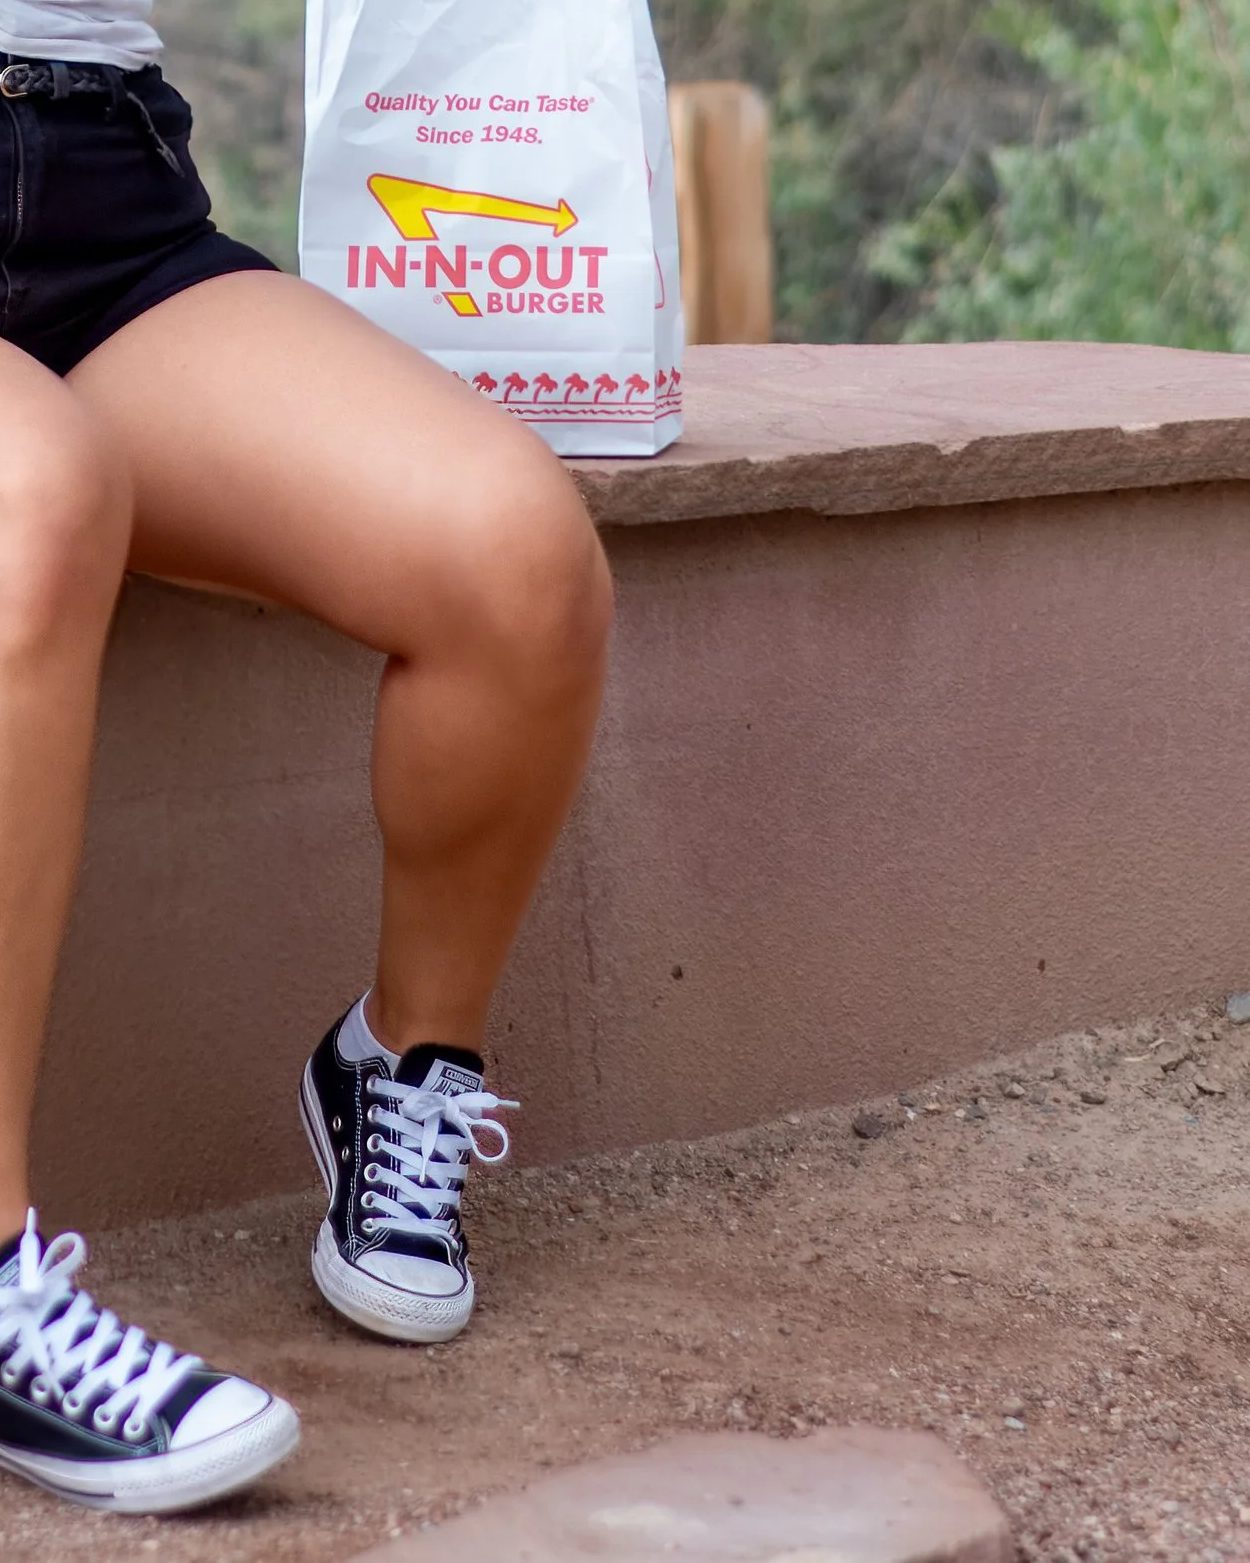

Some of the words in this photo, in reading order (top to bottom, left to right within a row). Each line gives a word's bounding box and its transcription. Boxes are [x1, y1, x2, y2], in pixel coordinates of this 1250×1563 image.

[365, 91, 439, 116] Quality
[445, 94, 481, 111] You
[488, 94, 530, 113] Can
[416, 125, 474, 144] Since
[481, 125, 543, 144] 1948.
[347, 244, 609, 290] IN-N-OUT
[486, 292, 605, 314] BURGER
